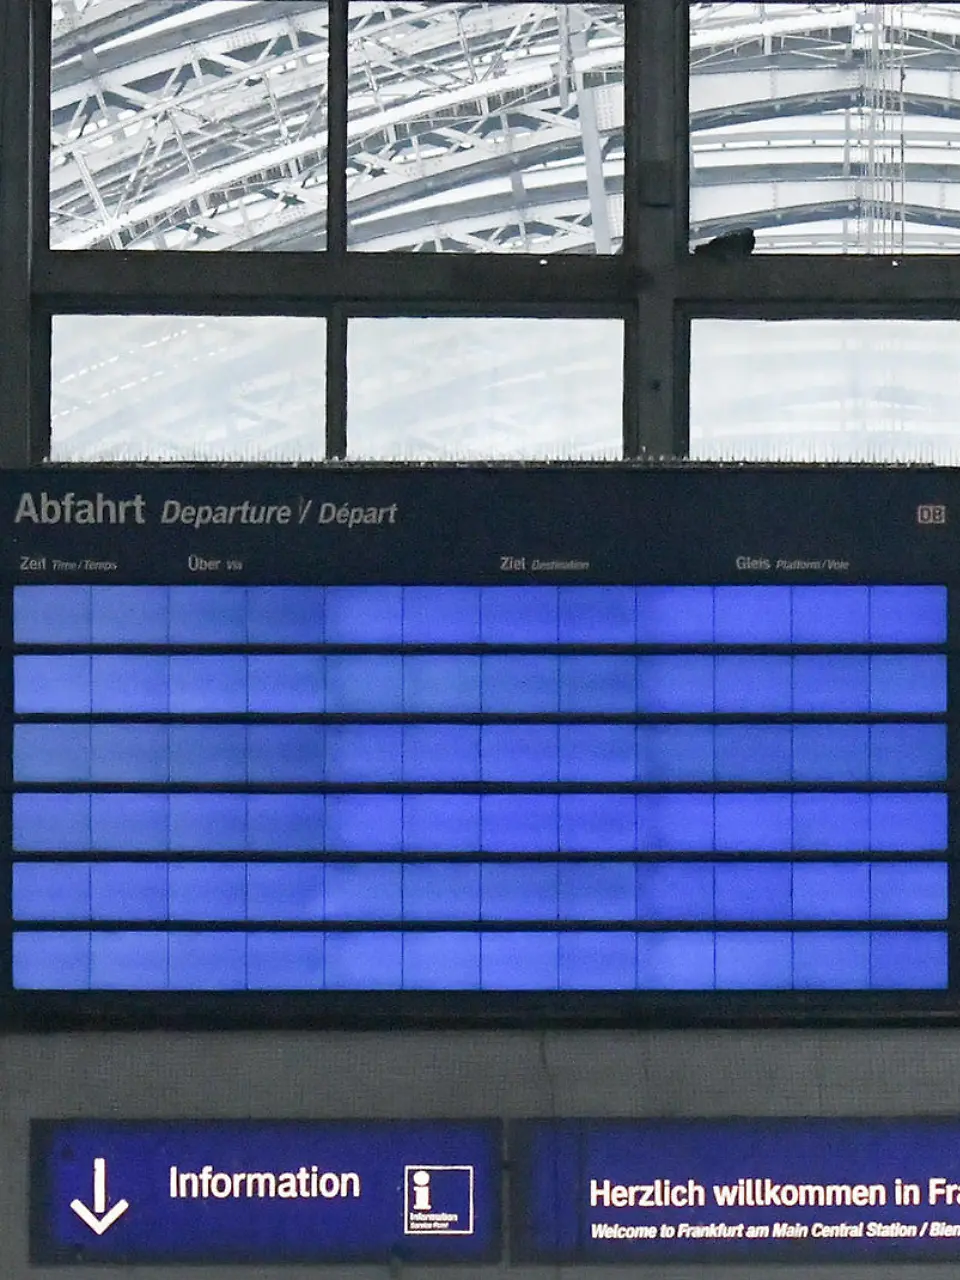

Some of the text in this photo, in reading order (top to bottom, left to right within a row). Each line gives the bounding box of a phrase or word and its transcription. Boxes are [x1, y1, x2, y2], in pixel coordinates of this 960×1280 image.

[15, 492, 146, 524] Abfahrt
[161, 500, 291, 528] Departure
[318, 501, 398, 529] Départ
[499, 556, 526, 571] Ziel
[735, 555, 771, 570] Gleis
[169, 1165, 360, 1198] Information
[590, 1179, 706, 1207] Herzlich
[712, 1178, 887, 1207] willkommen
[894, 1178, 921, 1206] in
[591, 1223, 657, 1239] Welcome
[660, 1224, 675, 1238] to
[677, 1222, 745, 1239] Frankfurt
[745, 1226, 769, 1238] am
[772, 1222, 809, 1238] Main
[811, 1222, 864, 1238] Central
[866, 1221, 918, 1238] Station
